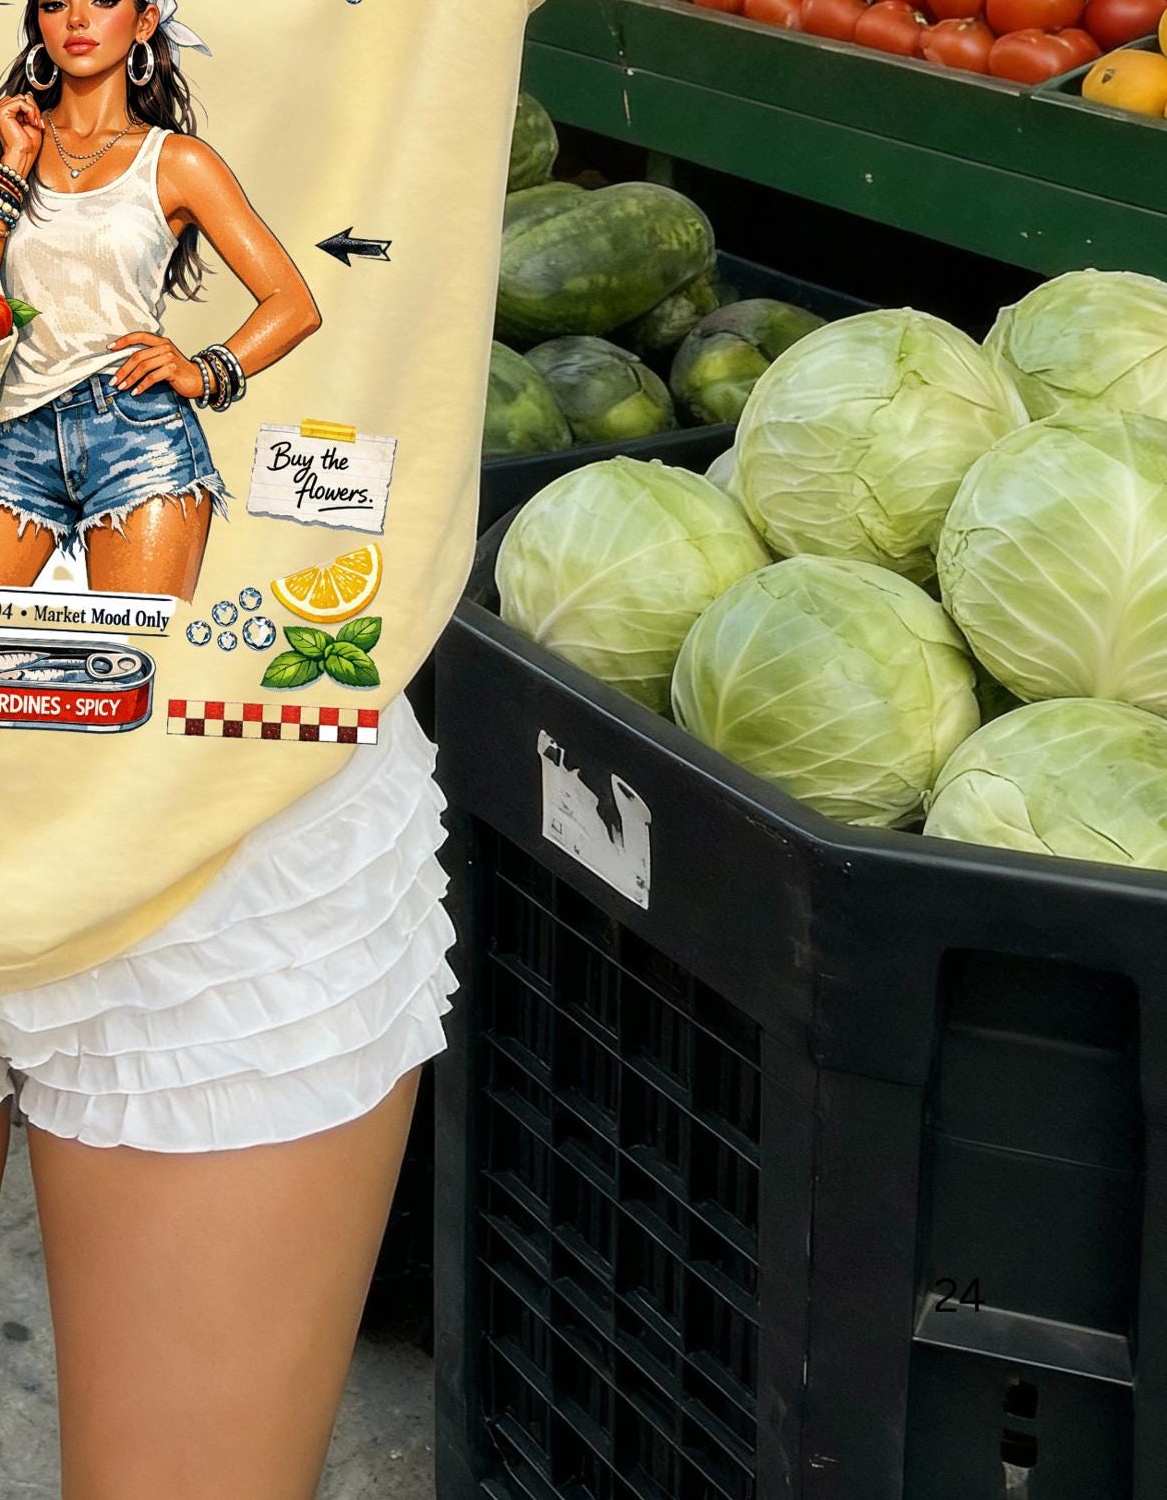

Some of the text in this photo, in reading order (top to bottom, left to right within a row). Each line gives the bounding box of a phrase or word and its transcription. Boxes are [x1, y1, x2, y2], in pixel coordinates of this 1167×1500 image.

[266, 441, 350, 484] Buy the
[295, 472, 374, 509] flowers.
[33, 604, 87, 624] Market
[91, 607, 131, 626] Mood
[135, 610, 170, 632] Only
[75, 697, 122, 717] SPICY
